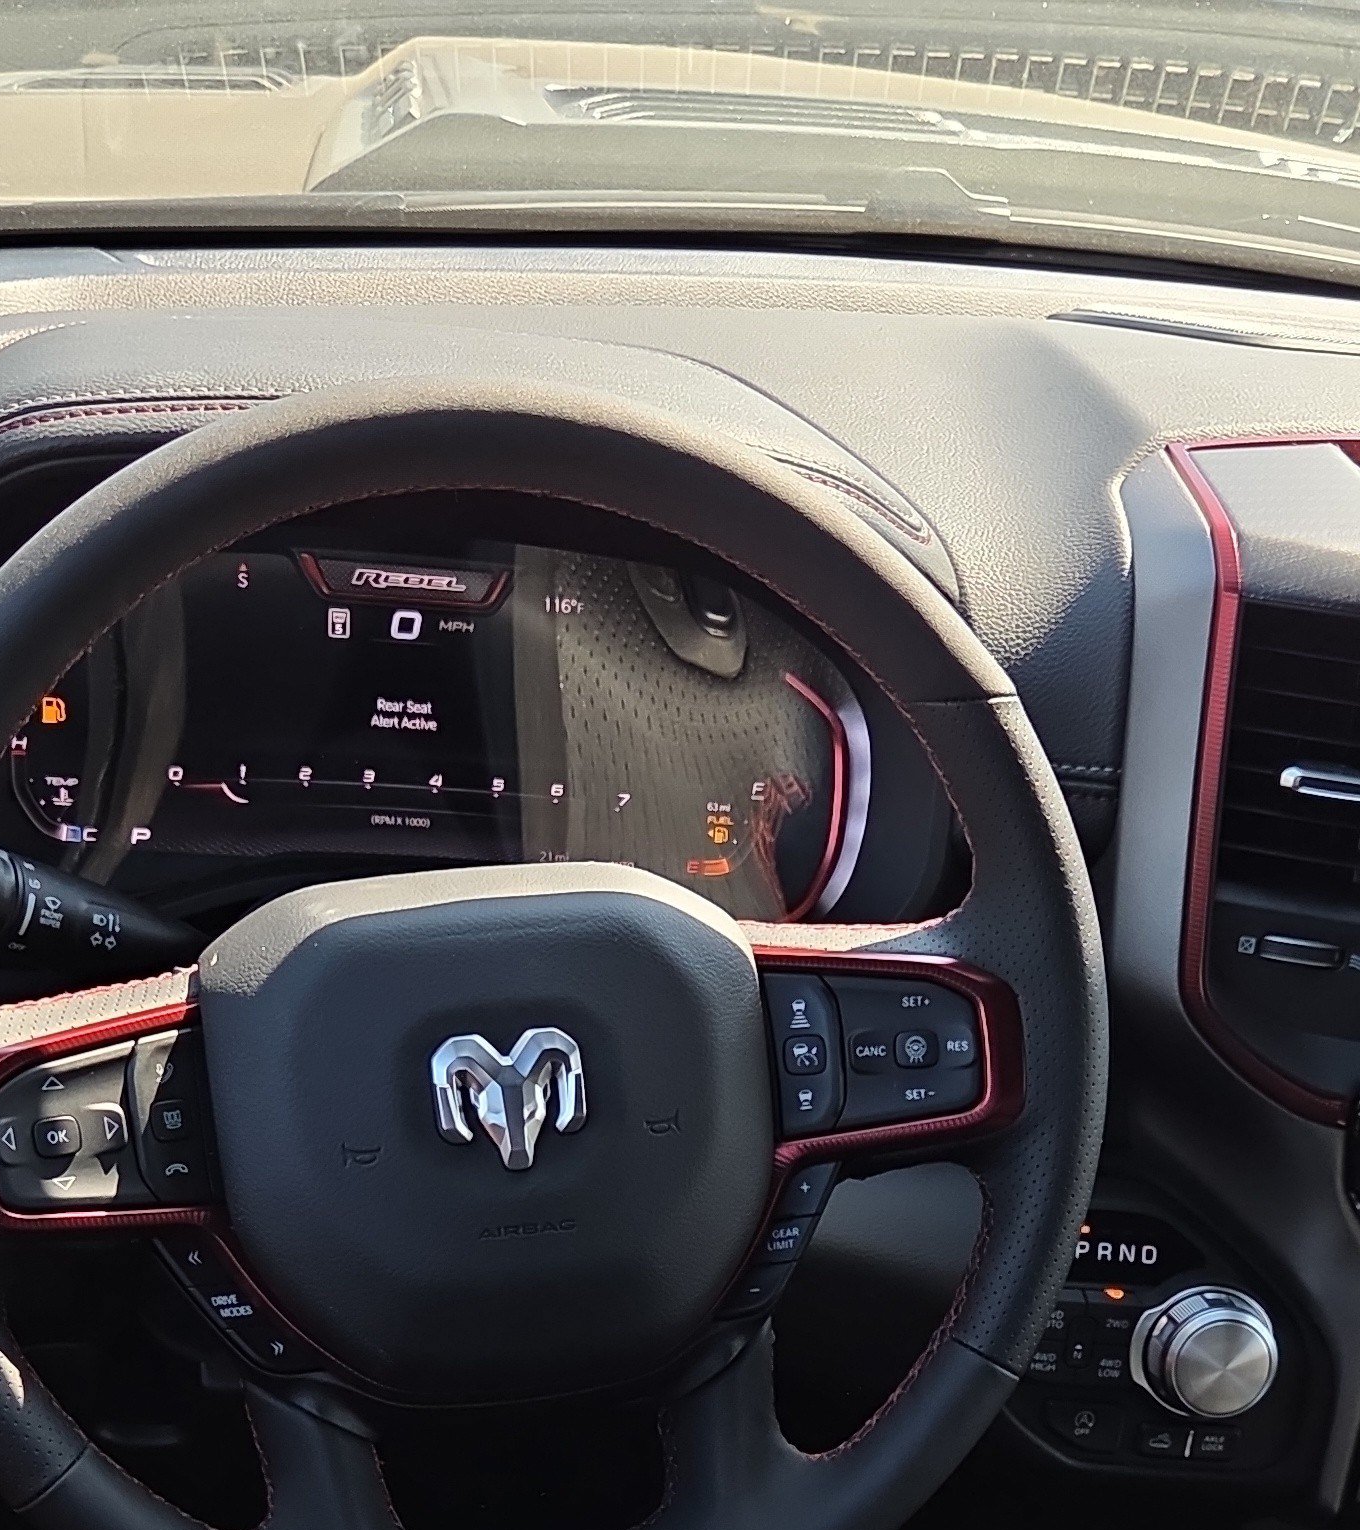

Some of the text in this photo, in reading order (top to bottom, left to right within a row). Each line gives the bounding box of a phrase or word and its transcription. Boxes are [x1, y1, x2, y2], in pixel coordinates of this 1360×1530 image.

[237, 573, 249, 589] S
[351, 568, 467, 592] REBEL
[439, 620, 475, 634] MPH
[376, 697, 432, 715] Rear Seat
[371, 714, 437, 731] Alert Active
[11, 735, 28, 750] H
[299, 766, 312, 781] 2
[362, 769, 376, 783] 3
[428, 774, 443, 788] 4
[492, 778, 505, 792] 5
[551, 784, 564, 797] 6
[617, 794, 631, 807] 7
[83, 828, 98, 842] C
[130, 827, 152, 845] P
[855, 1045, 887, 1057] CANC
[947, 1040, 969, 1052] RES
[47, 1130, 69, 1145] OK
[479, 1218, 577, 1240] AIRBAG
[772, 1227, 800, 1239] GEAR
[768, 1239, 795, 1251] LIMIT
[211, 1294, 238, 1307] DRIVE
[220, 1305, 253, 1317] MODES
